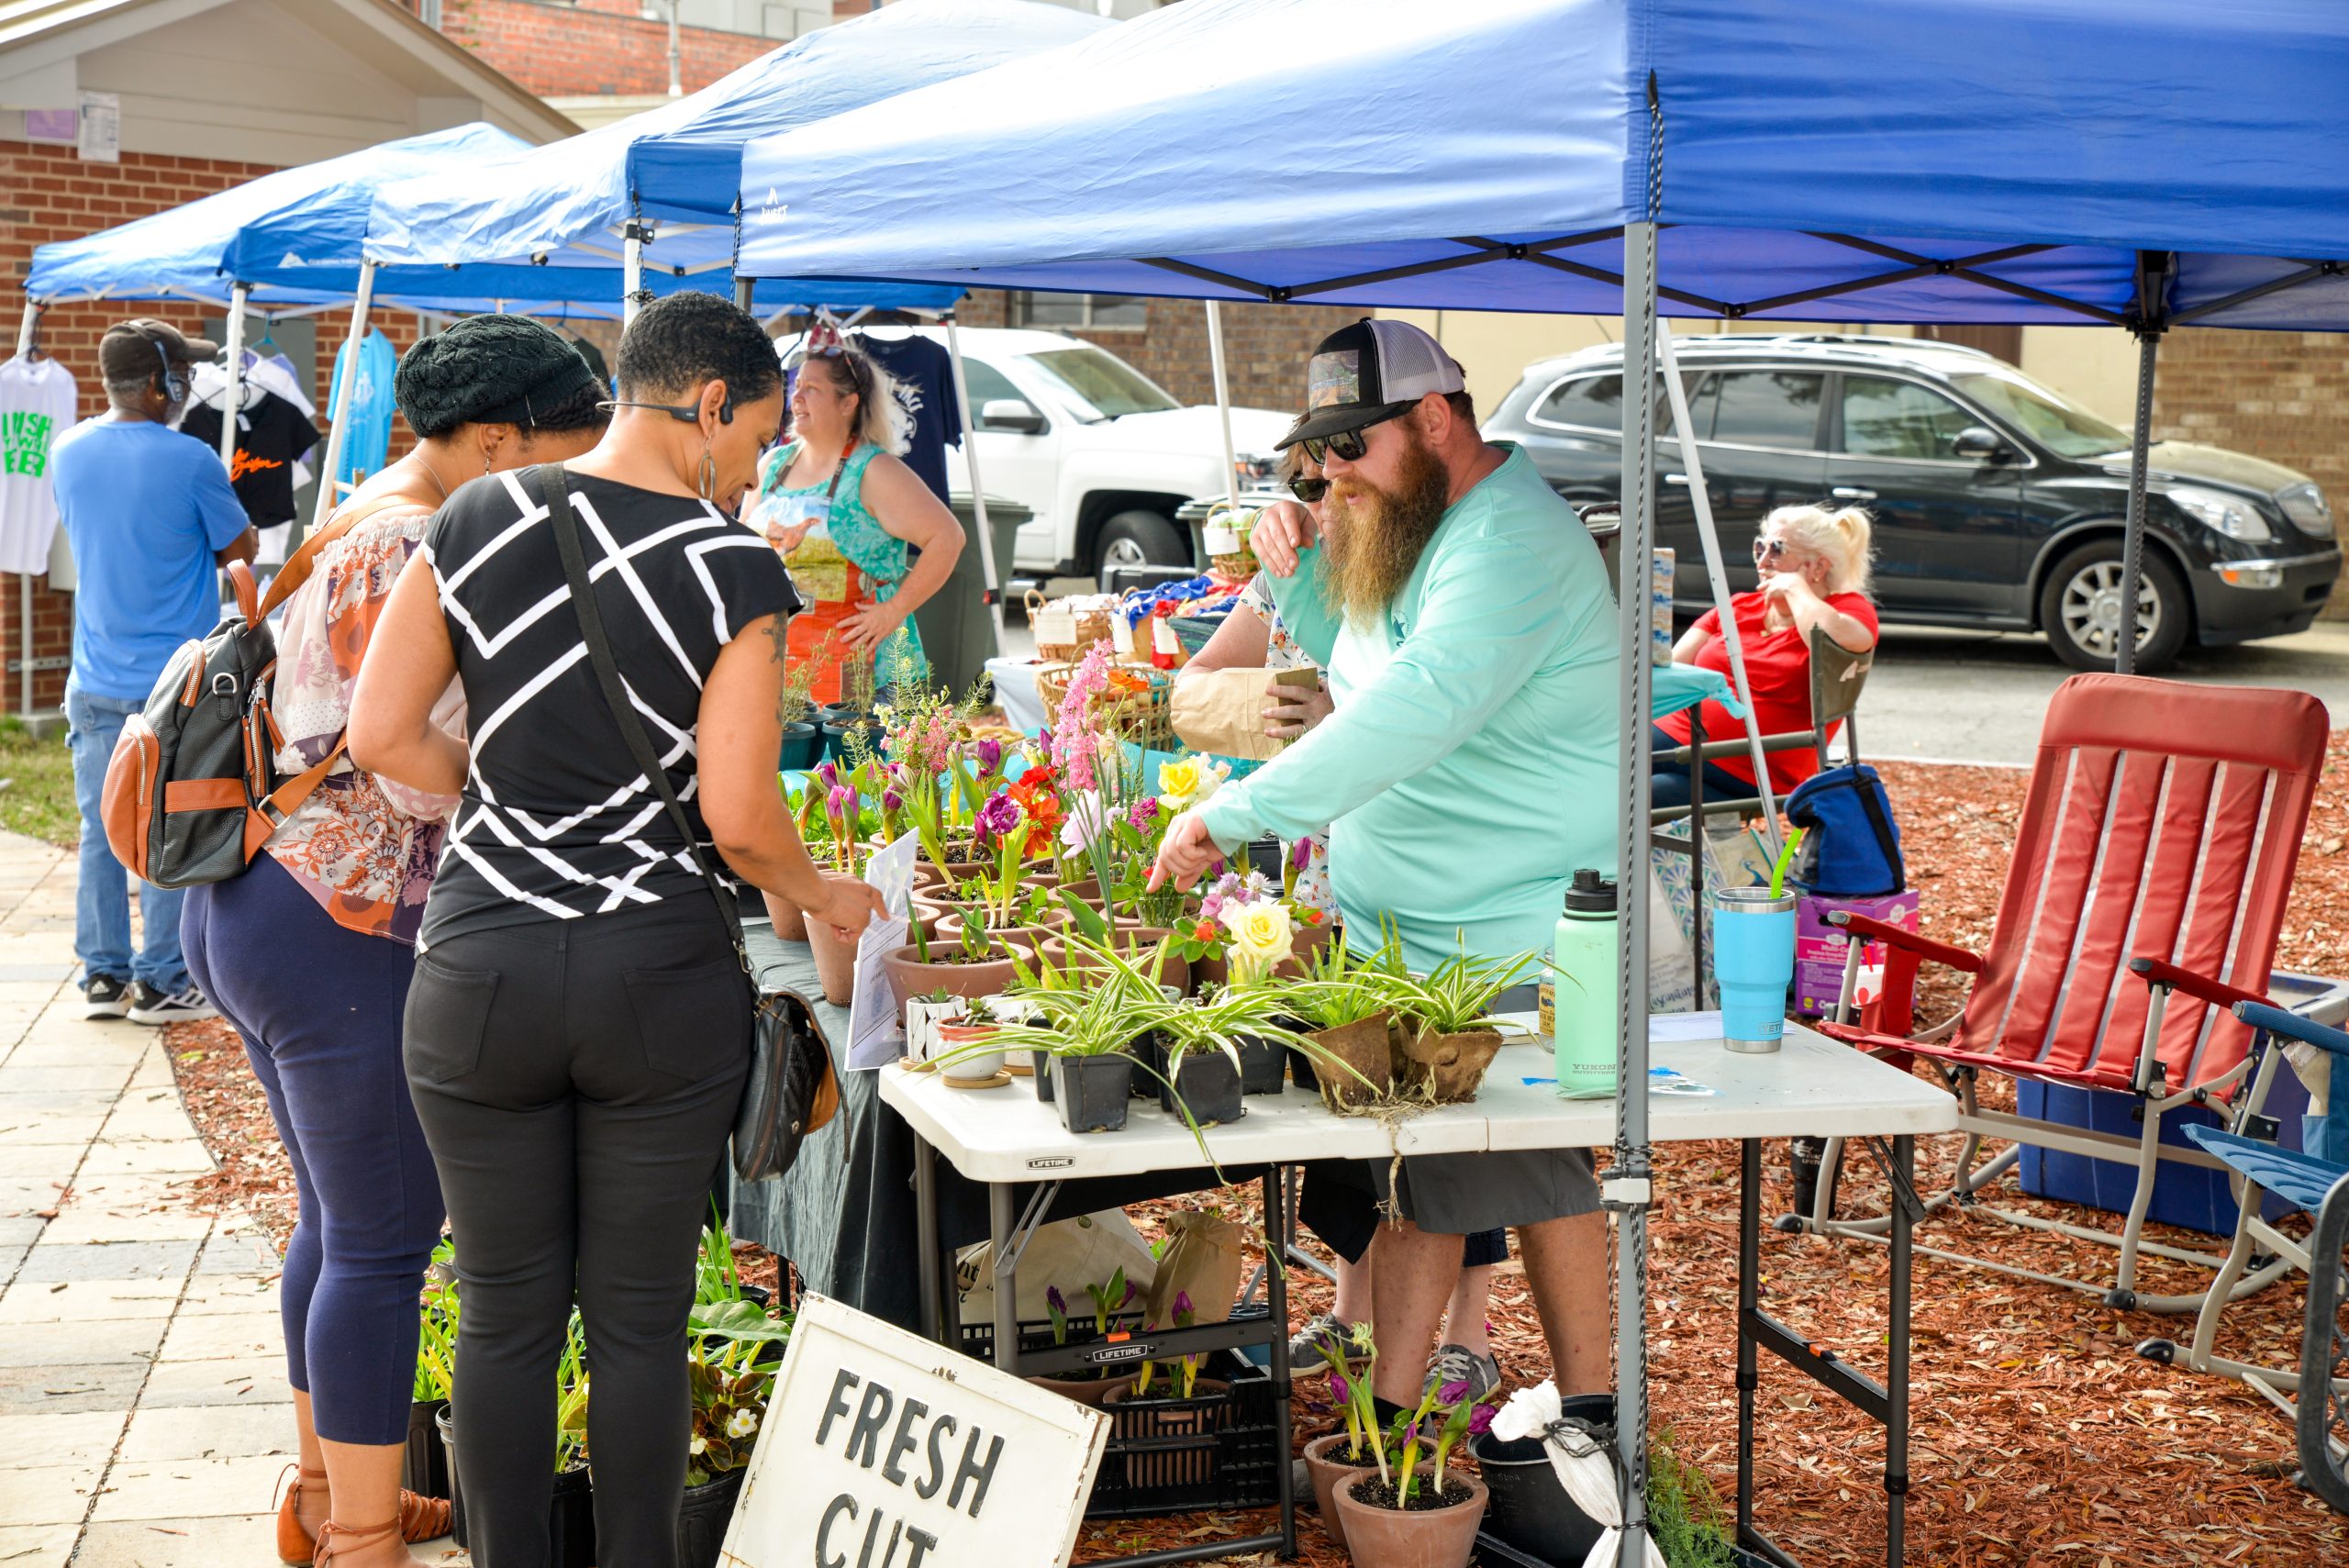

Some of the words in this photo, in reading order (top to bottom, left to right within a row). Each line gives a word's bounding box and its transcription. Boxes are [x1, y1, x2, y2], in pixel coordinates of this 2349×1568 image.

[1762, 1023, 1781, 1033] YETI
[1032, 1159, 1069, 1167] LIFETIME
[1099, 1347, 1141, 1360] LIFETIME
[815, 1368, 1005, 1518] FRESH
[815, 1493, 938, 1568] CUT
